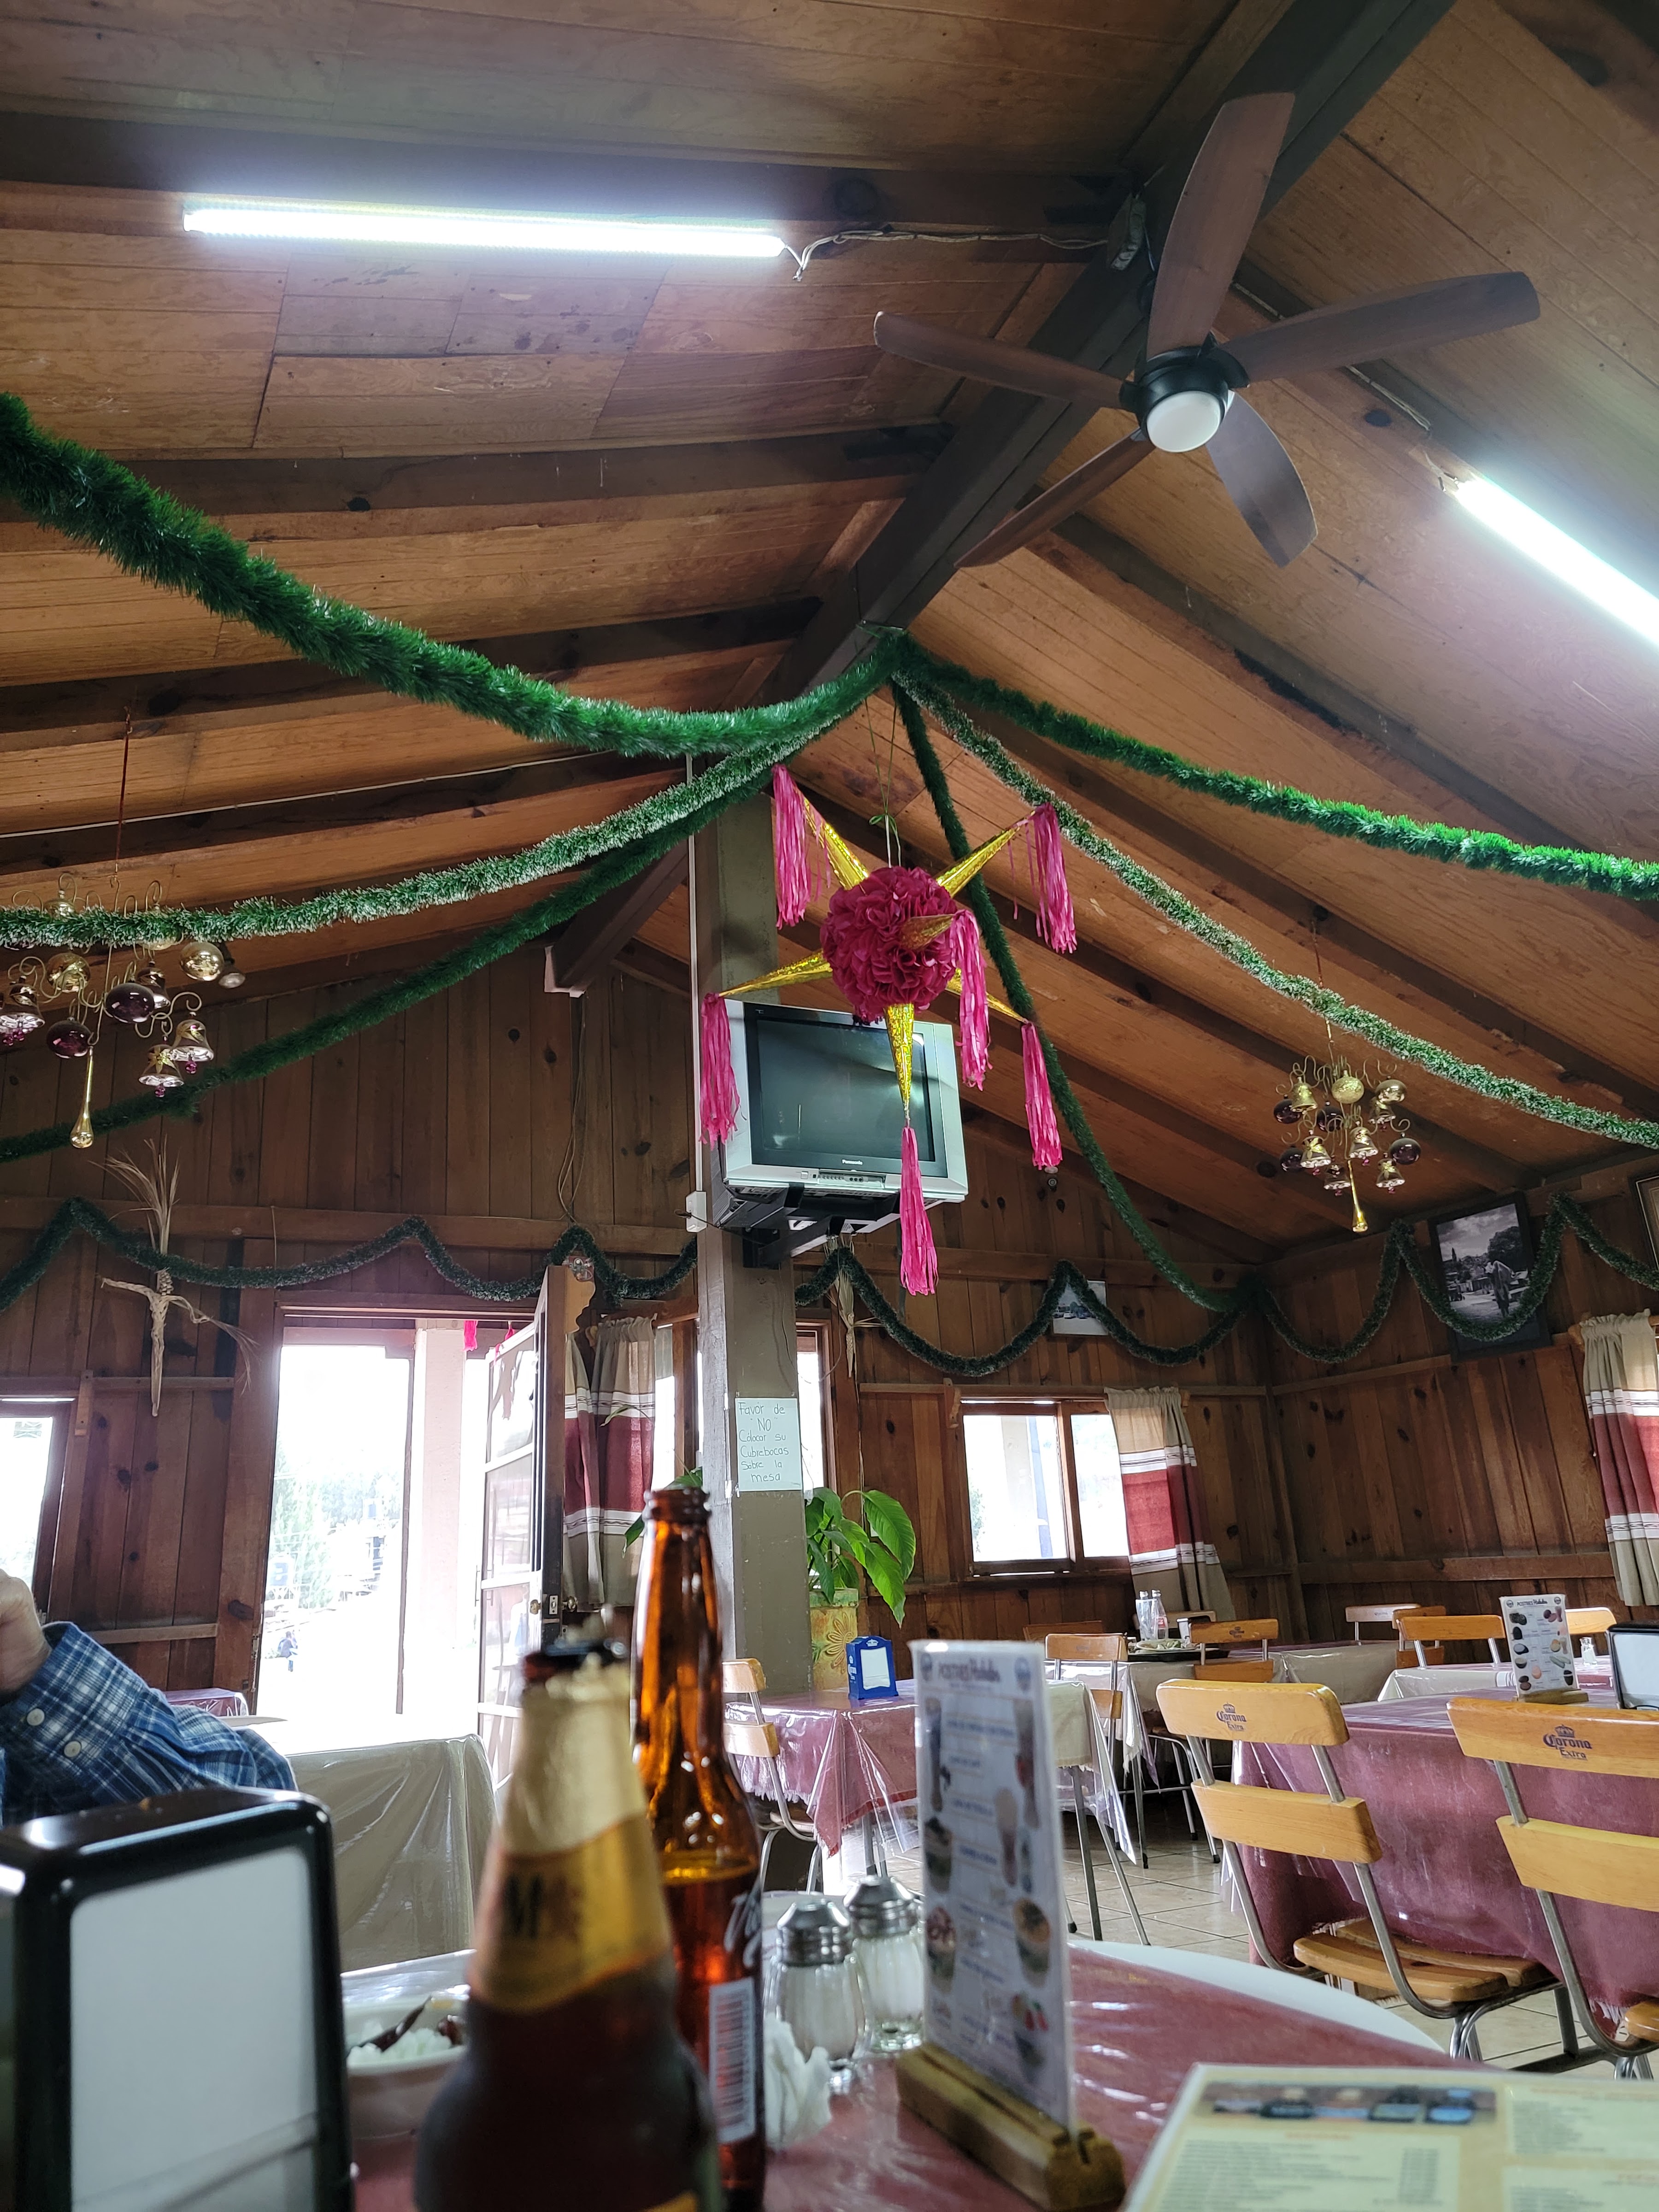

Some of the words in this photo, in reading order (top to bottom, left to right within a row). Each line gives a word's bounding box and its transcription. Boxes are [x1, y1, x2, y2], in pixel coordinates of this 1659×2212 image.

[774, 1403, 785, 1414] de
[740, 1445, 789, 1458] Cubrebocas
[774, 1459, 782, 1468] la
[751, 1473, 780, 1483] mesa
[1216, 1711, 1247, 1723] Corona
[1227, 1722, 1244, 1730] Extra
[1543, 1734, 1592, 1750] Corona
[1559, 1747, 1587, 1759] Extra
